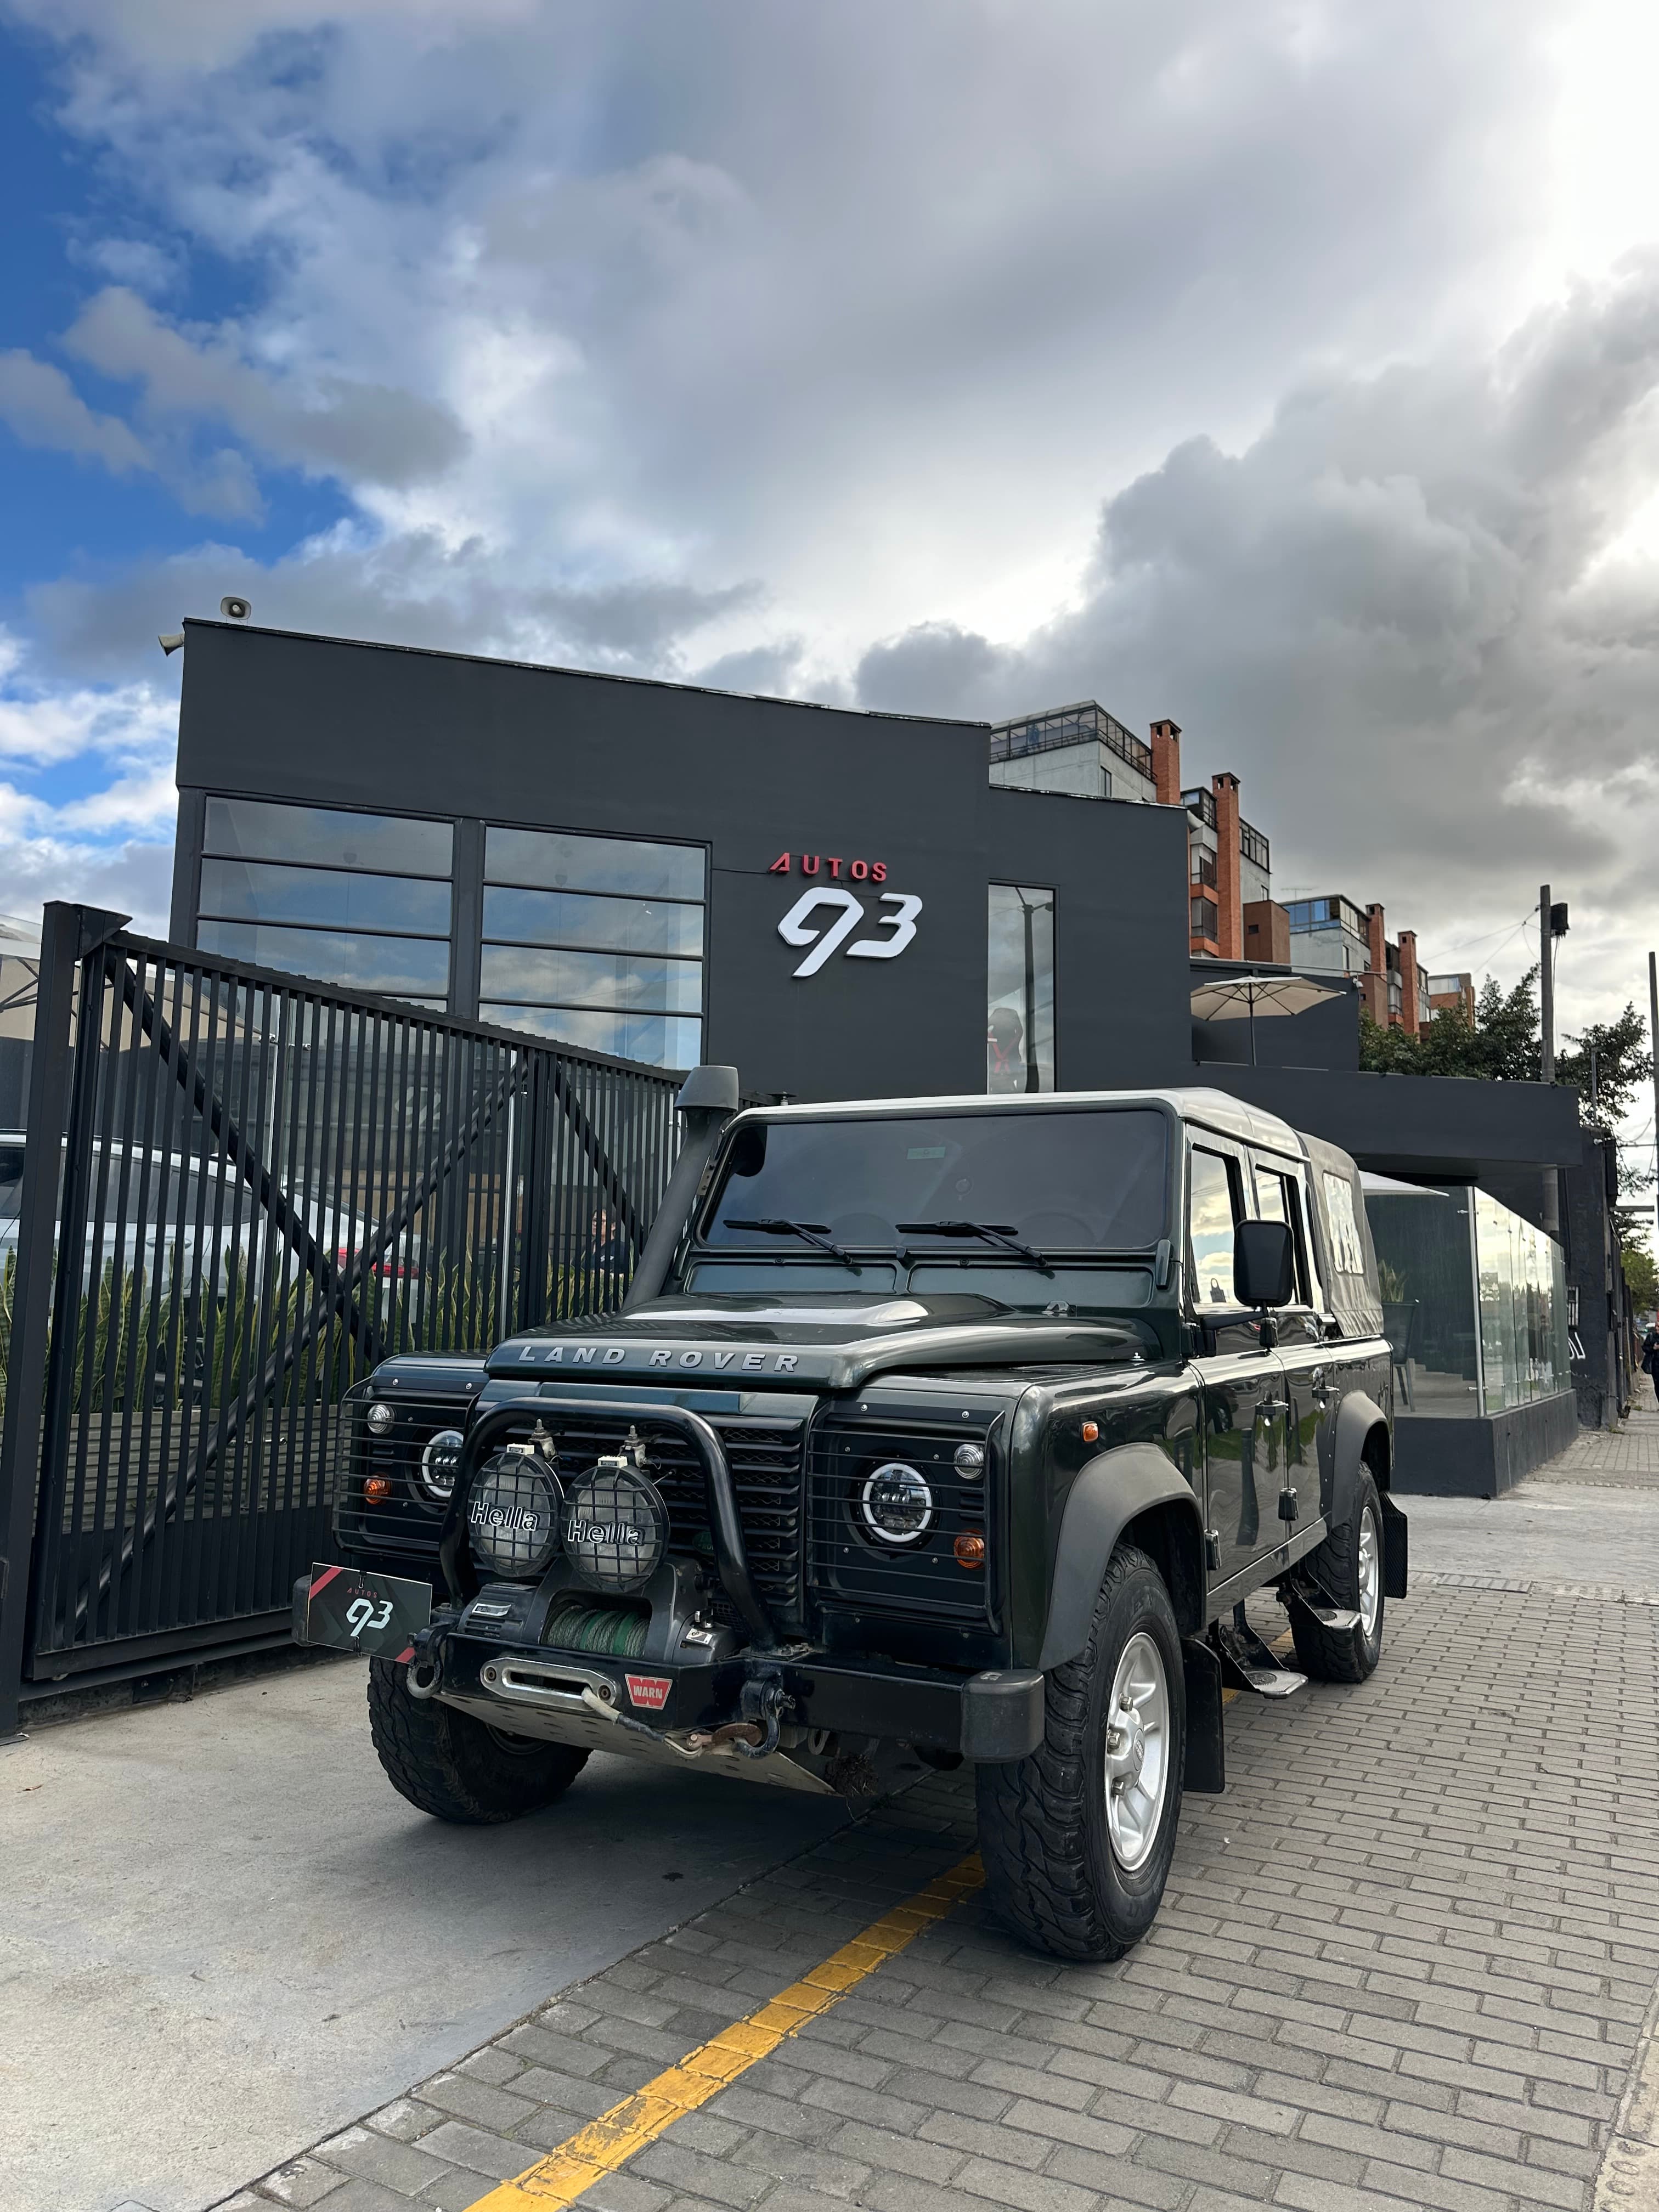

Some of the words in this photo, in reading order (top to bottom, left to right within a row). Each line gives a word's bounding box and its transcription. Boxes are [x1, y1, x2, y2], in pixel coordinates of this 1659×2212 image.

[769, 852, 887, 882] AUTOS
[777, 887, 923, 978] 93
[518, 1346, 625, 1364] LAND
[648, 1350, 799, 1372] ROVER
[471, 1501, 539, 1531] Hella
[567, 1519, 644, 1546] Hella
[347, 1587, 377, 1598] AUTOS
[346, 1598, 393, 1637] 93
[633, 1685, 663, 1699] WARN
